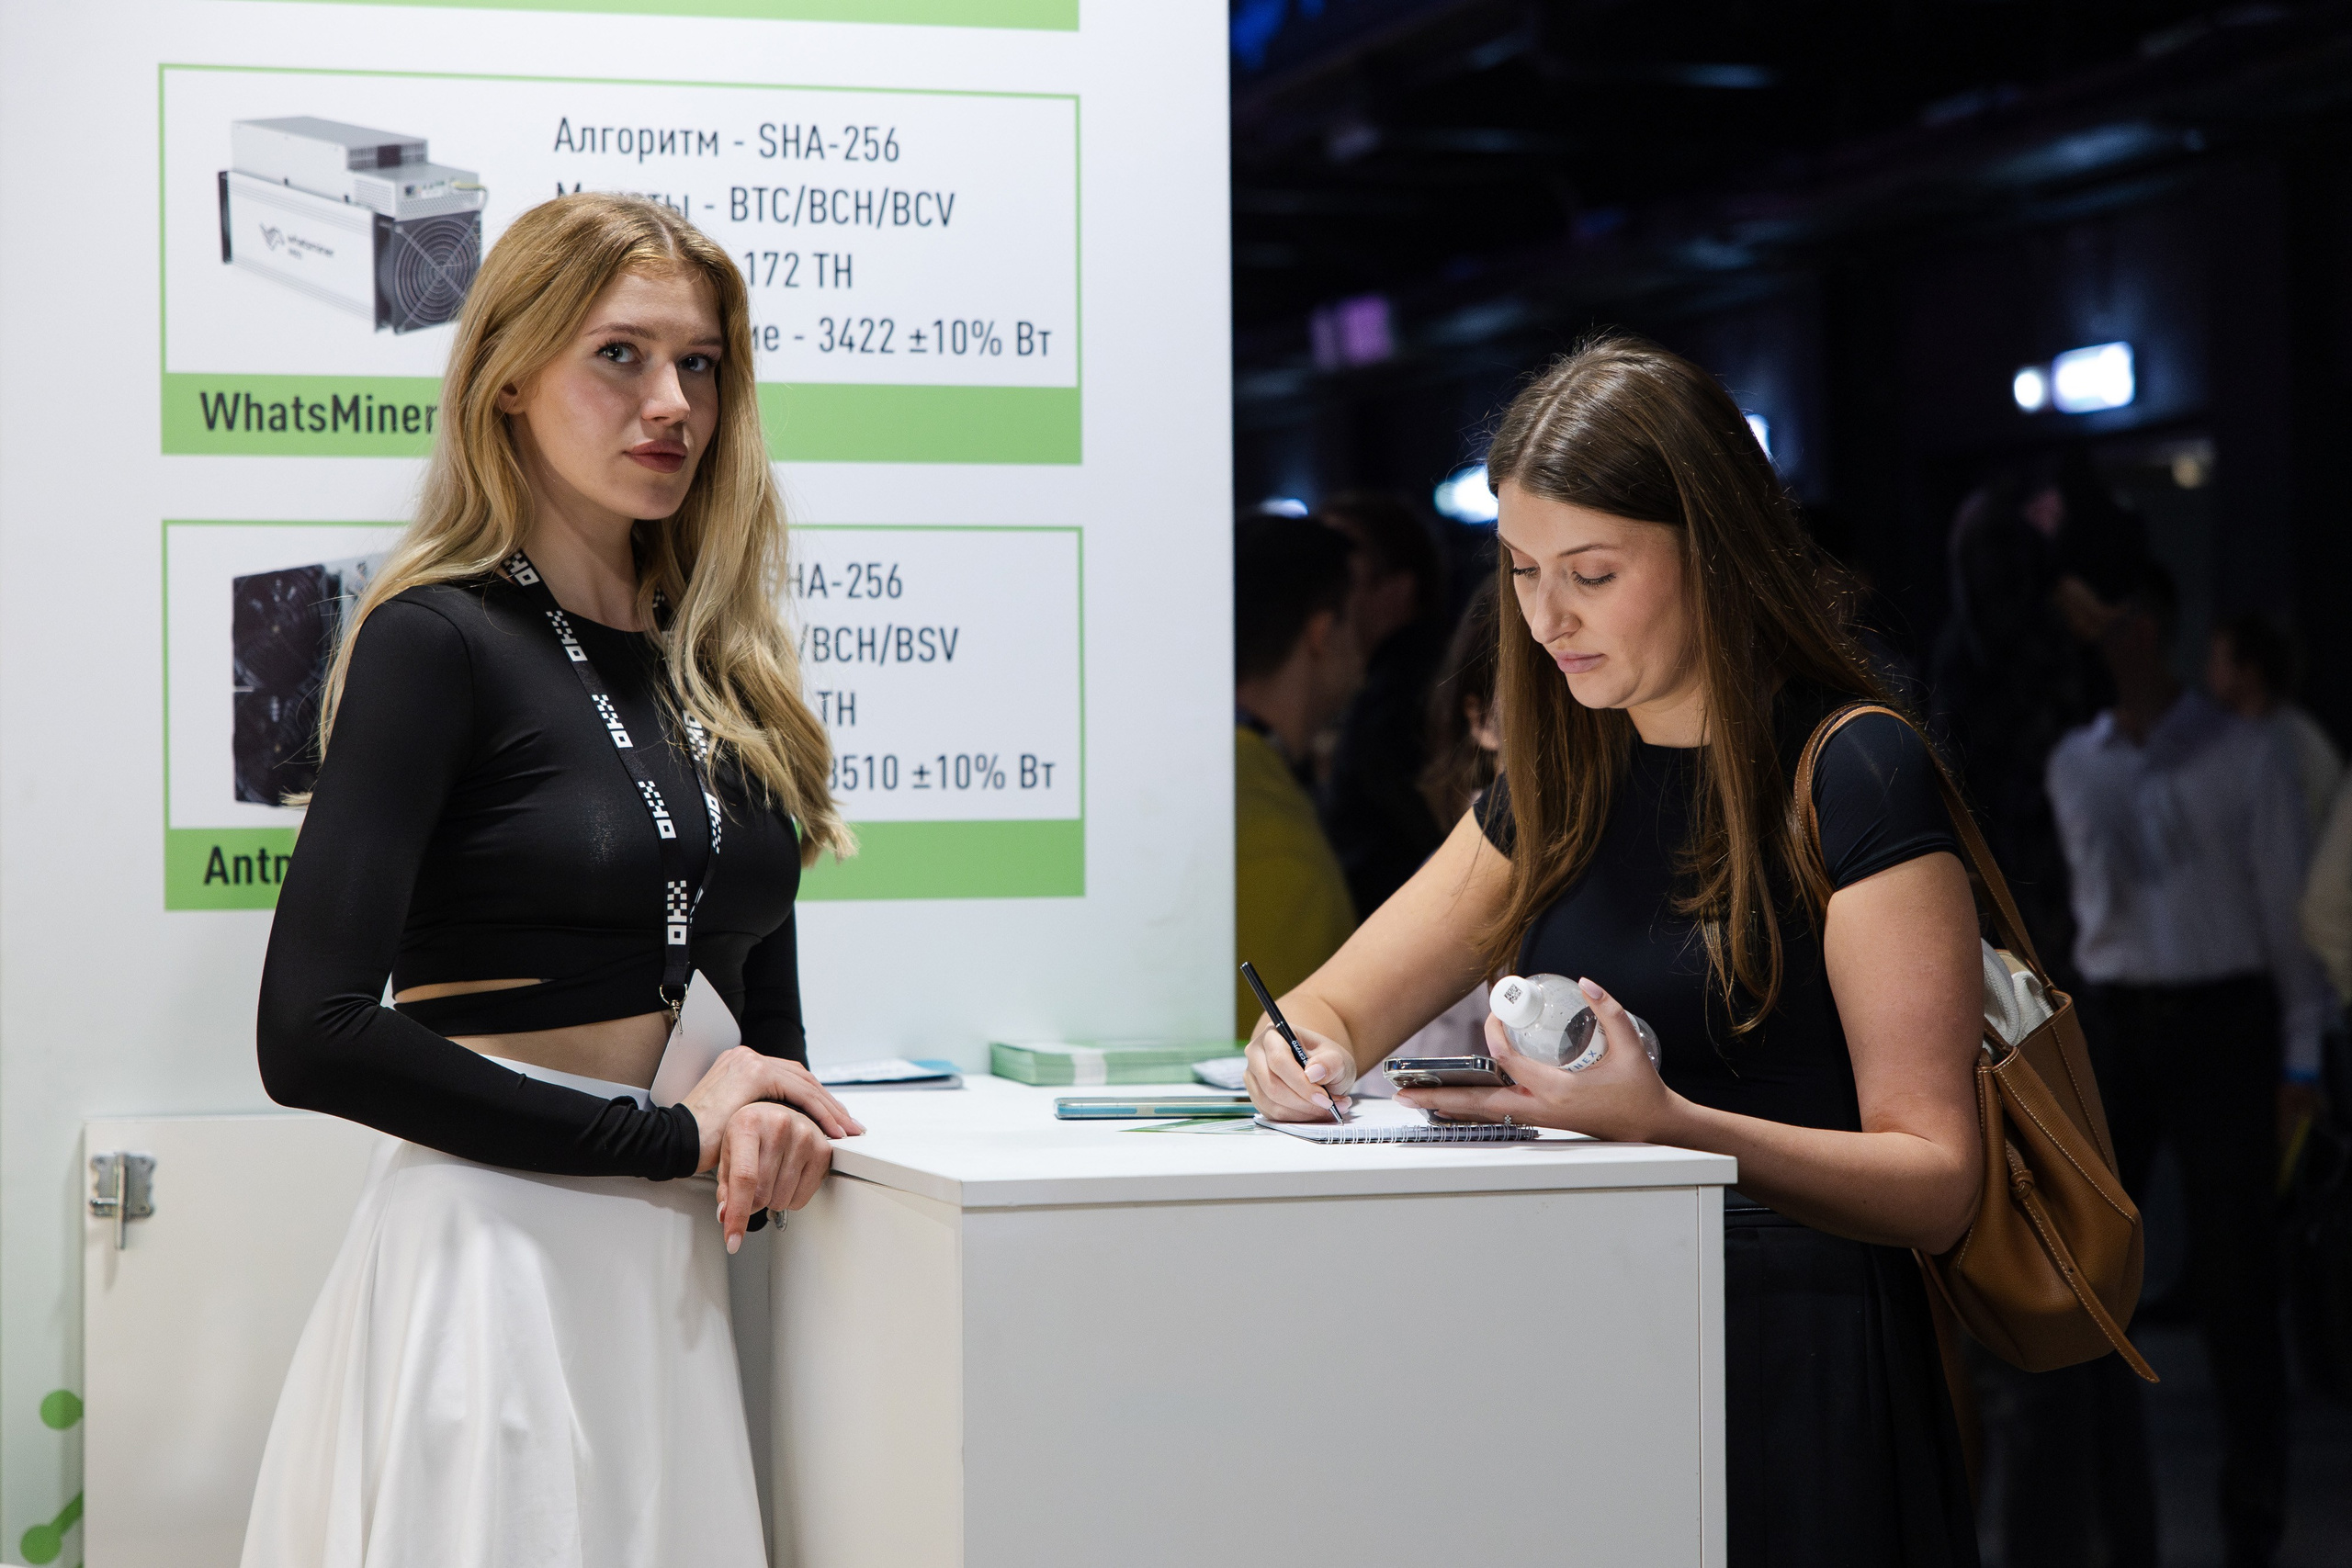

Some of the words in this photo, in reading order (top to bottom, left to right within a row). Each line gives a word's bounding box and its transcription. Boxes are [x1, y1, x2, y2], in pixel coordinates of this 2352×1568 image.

[553, 117, 718, 164] Алгоритм
[759, 122, 899, 163] SHA-256
[730, 185, 956, 230] BTC/BCH/BCV
[744, 251, 798, 288] 172
[812, 253, 853, 289] TH
[819, 316, 895, 355] 3422
[909, 319, 1002, 356] ±10%
[1016, 321, 1052, 356] Вт
[199, 391, 437, 434] WhatsMiner
[770, 562, 903, 600] HA-256
[816, 691, 855, 727] TH
[912, 753, 1006, 791] ±10%
[1020, 753, 1056, 789] Вт
